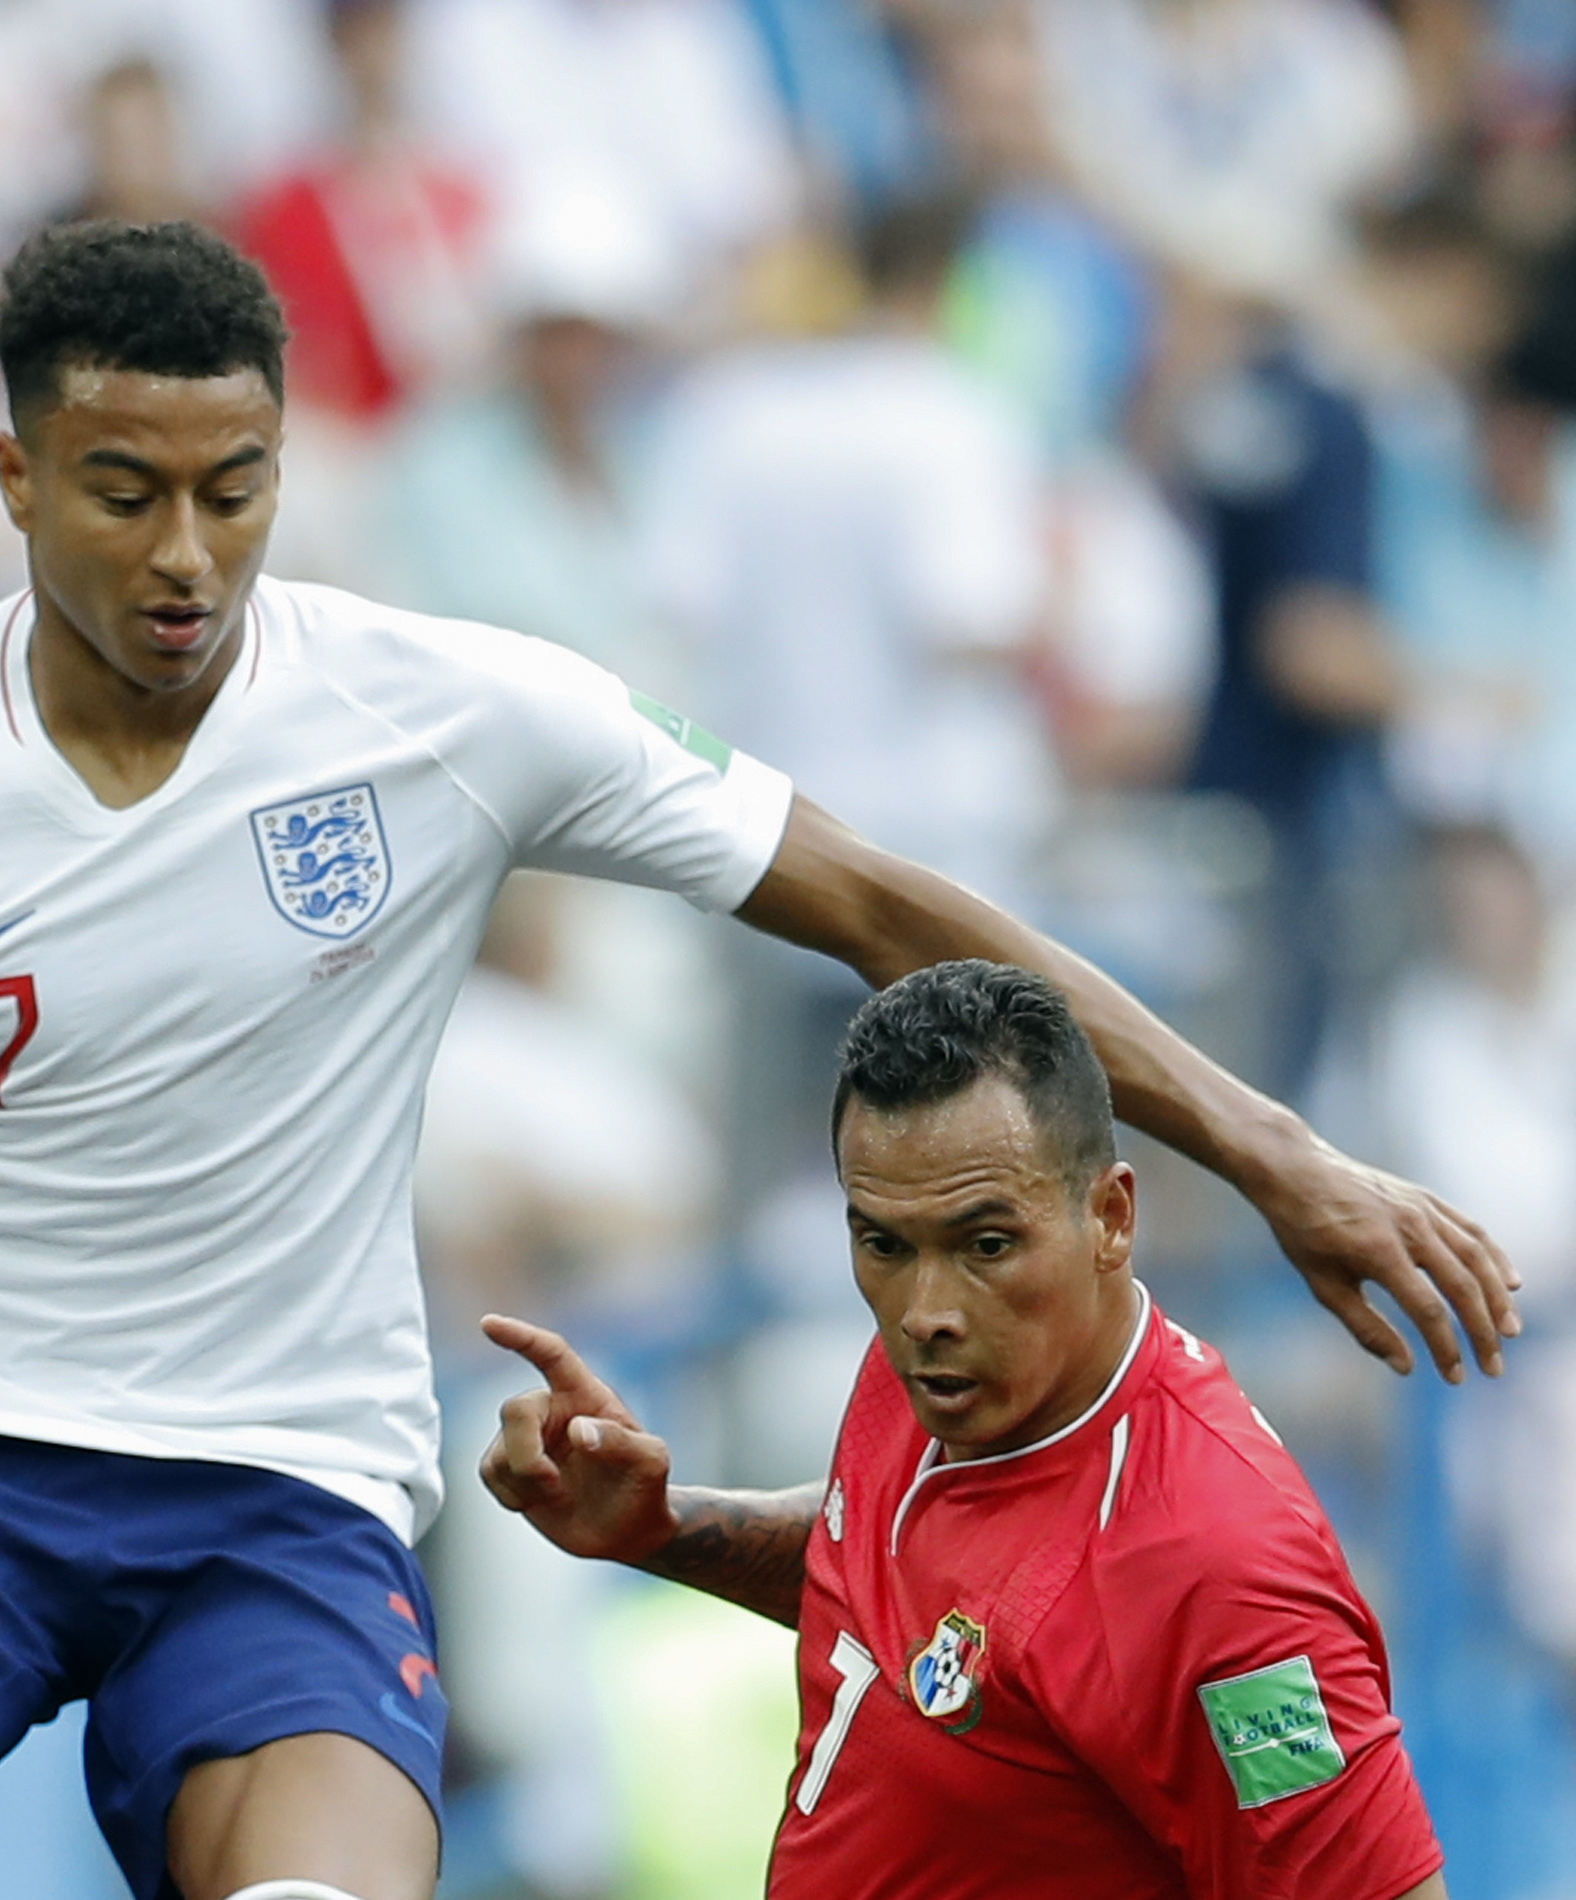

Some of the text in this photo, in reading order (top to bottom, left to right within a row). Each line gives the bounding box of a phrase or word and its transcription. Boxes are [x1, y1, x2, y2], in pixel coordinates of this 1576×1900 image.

[795, 1629, 881, 1817] 7
[1217, 1697, 1312, 1735] LIVING
[1288, 1735, 1325, 1757] FIFA
